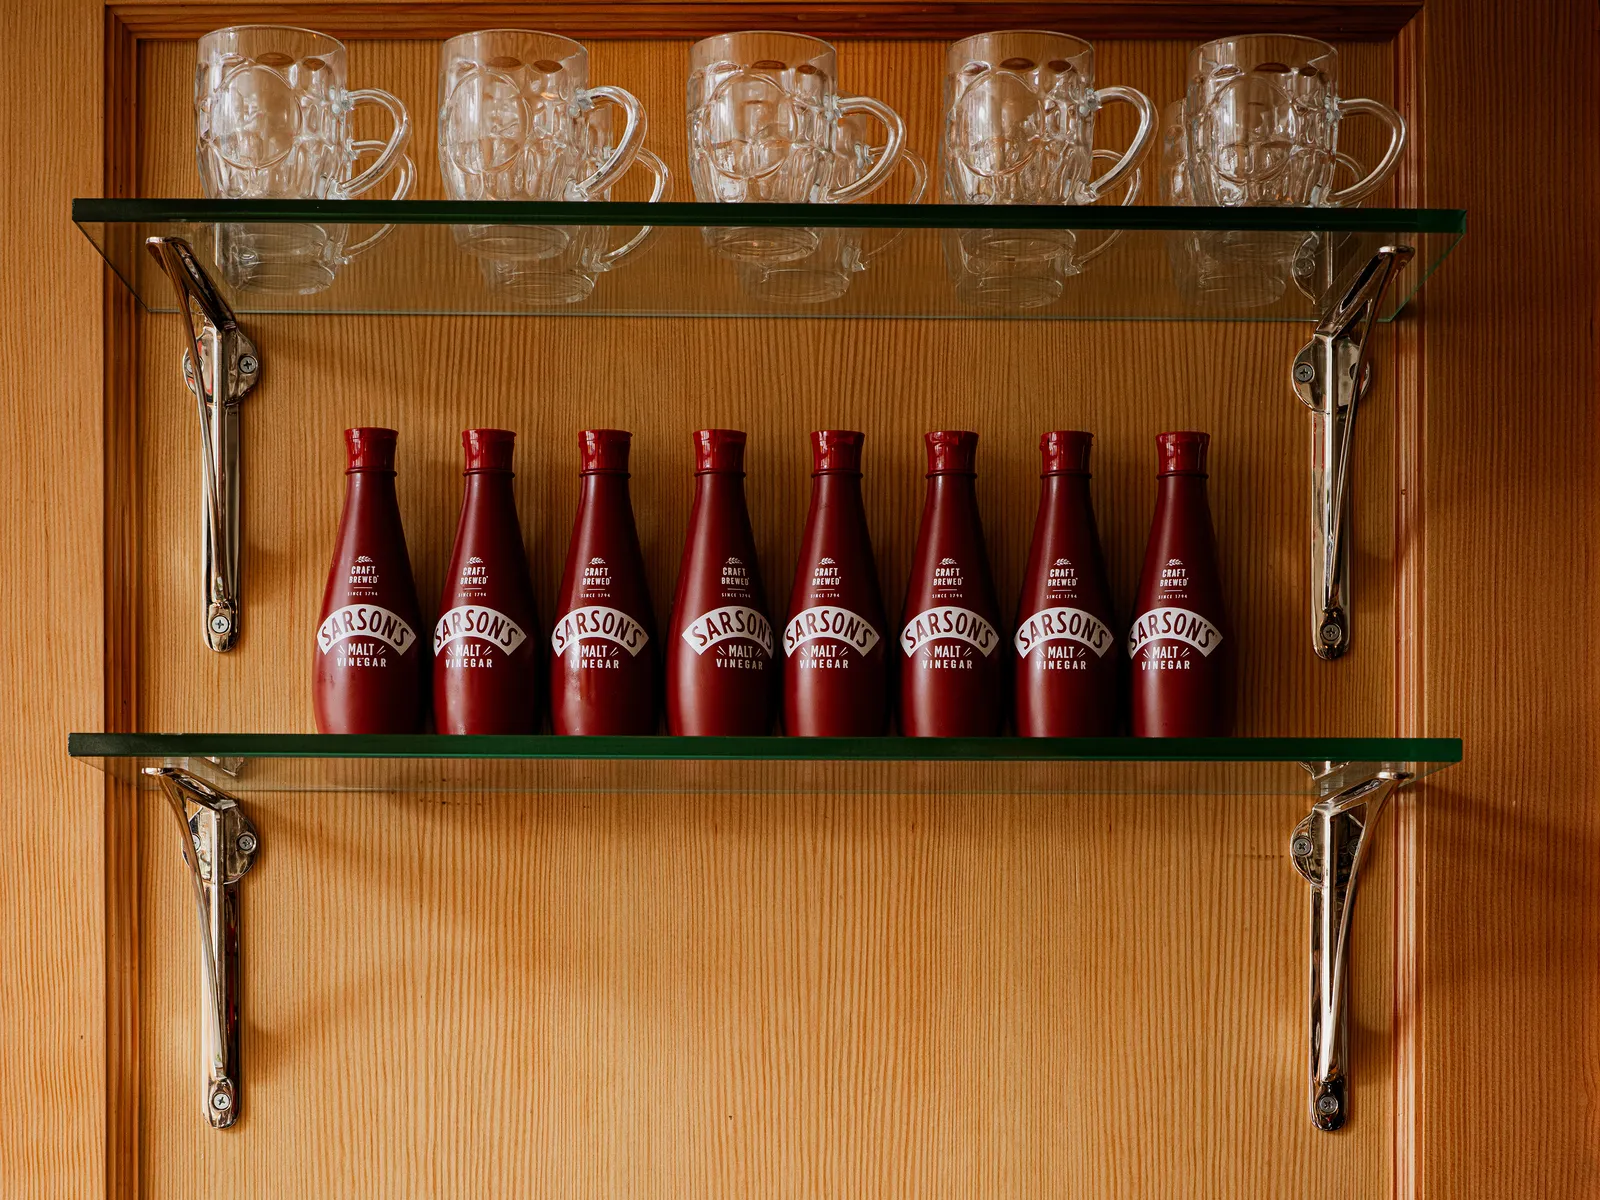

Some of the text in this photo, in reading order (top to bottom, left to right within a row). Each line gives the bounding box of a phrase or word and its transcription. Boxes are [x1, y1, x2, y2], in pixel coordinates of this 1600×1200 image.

[351, 565, 376, 575] CRAFT
[462, 567, 486, 576] CRAFT
[584, 567, 609, 576] CRAFT
[722, 567, 746, 576] CRAFT
[814, 567, 839, 576] CRAFT
[935, 568, 960, 577] CRAFT
[1049, 569, 1075, 577] CRAFT
[1162, 569, 1186, 577] CRAFT
[348, 576, 378, 584] BREWED
[460, 576, 487, 585] BREWED
[721, 577, 749, 586] BREWED
[812, 578, 840, 586] BREWED
[933, 578, 962, 586] BREWED
[1047, 579, 1077, 587] BREWED
[1160, 579, 1187, 587] BREWED
[321, 608, 410, 647] SARSON'S
[435, 609, 518, 648] SARSON'S
[555, 610, 642, 649] SARSON'S
[692, 609, 773, 650] SARSON'S
[785, 610, 872, 649] SARSON'S
[905, 610, 993, 649] SARSON'S
[1019, 611, 1108, 650] SARSON'S
[1129, 611, 1215, 651] SARSON'S
[348, 643, 375, 656] MALT
[455, 644, 481, 657] MALT
[581, 645, 607, 658] MALT
[728, 644, 753, 658] MALT
[811, 645, 837, 658] MALT
[934, 645, 961, 658] MALT
[1047, 646, 1074, 659] MALT
[1152, 646, 1178, 659] MALT
[336, 658, 387, 667] VINEGAR
[445, 658, 492, 668] VINEGAR
[570, 659, 619, 669] VINEGAR
[716, 658, 763, 670] VINEGAR
[800, 659, 849, 669] VINEGAR
[923, 660, 973, 669] VINEGAR
[1036, 660, 1086, 670] VINEGAR
[1141, 660, 1190, 670] VINEGAR
